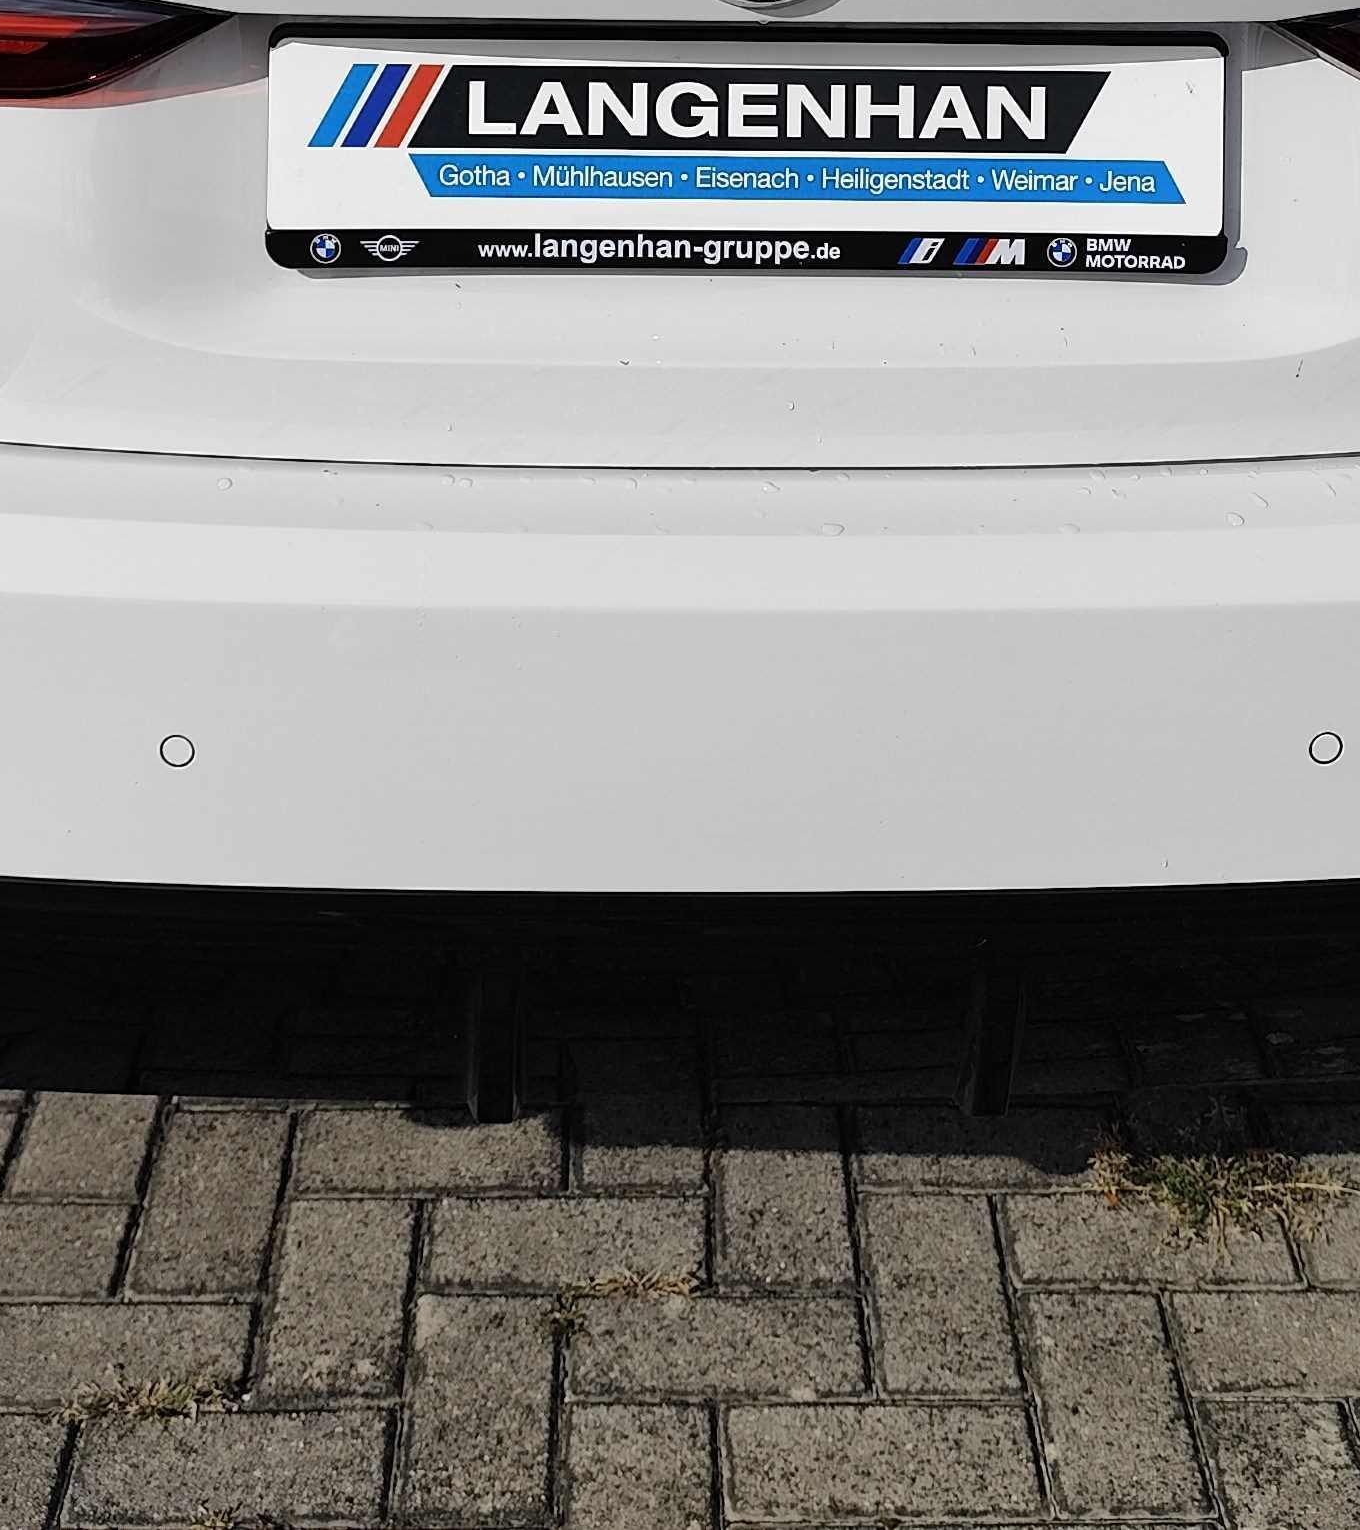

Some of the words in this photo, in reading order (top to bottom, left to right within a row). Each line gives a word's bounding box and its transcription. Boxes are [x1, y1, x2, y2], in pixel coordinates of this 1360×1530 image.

[468, 80, 1046, 140] LANGENHAN
[439, 164, 511, 187] Gotha
[533, 165, 673, 188] Mühlhausen
[696, 166, 799, 190] Eisenach
[822, 168, 970, 195] Heiligenstadt
[991, 170, 1078, 192] Weimar
[1099, 171, 1156, 193] Jena
[477, 233, 841, 265] www.langenhan-gruppe.de
[1086, 237, 1132, 252] BMW
[1085, 254, 1186, 270] MOTORRAD
